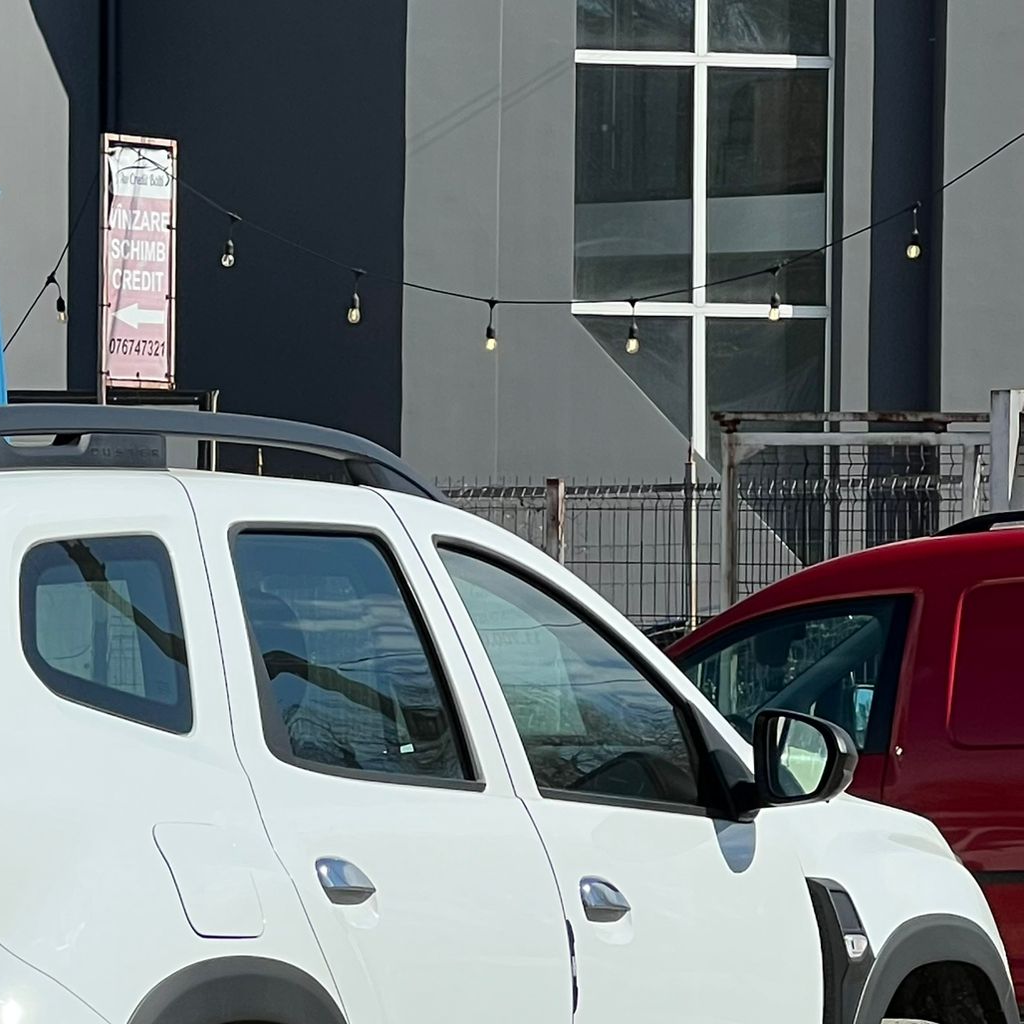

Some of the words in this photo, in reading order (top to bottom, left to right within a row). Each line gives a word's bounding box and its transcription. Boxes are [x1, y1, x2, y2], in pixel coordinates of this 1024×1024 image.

[111, 239, 166, 262] SCHIMB
[112, 269, 164, 292] CREDIT
[109, 338, 165, 357] 076747321
